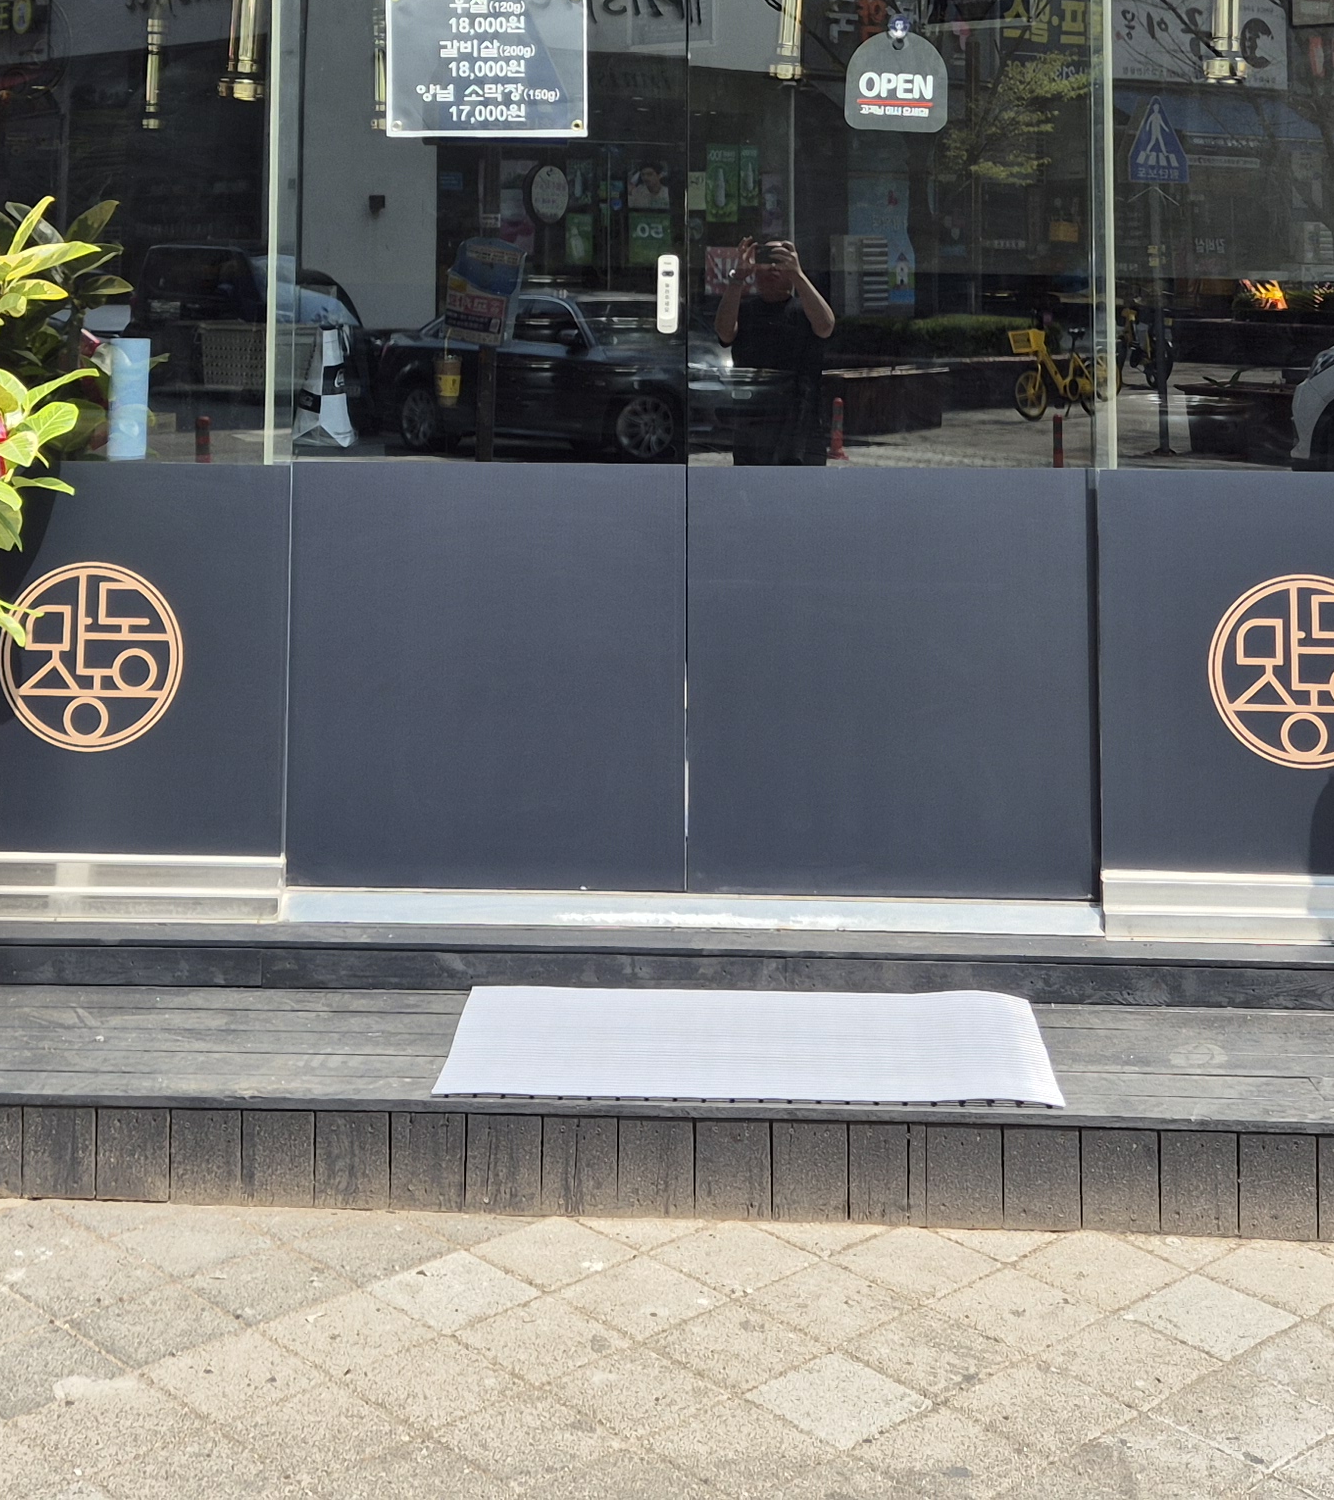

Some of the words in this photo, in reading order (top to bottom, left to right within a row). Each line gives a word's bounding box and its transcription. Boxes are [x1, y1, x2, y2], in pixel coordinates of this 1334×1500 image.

[448, 15, 526, 35] 18,000원
[439, 39, 535, 58] 갈비살(200g)
[448, 59, 526, 79] 18,000원
[416, 83, 455, 102] 양념
[858, 71, 934, 100] OPEN
[449, 103, 526, 123] 17,000원
